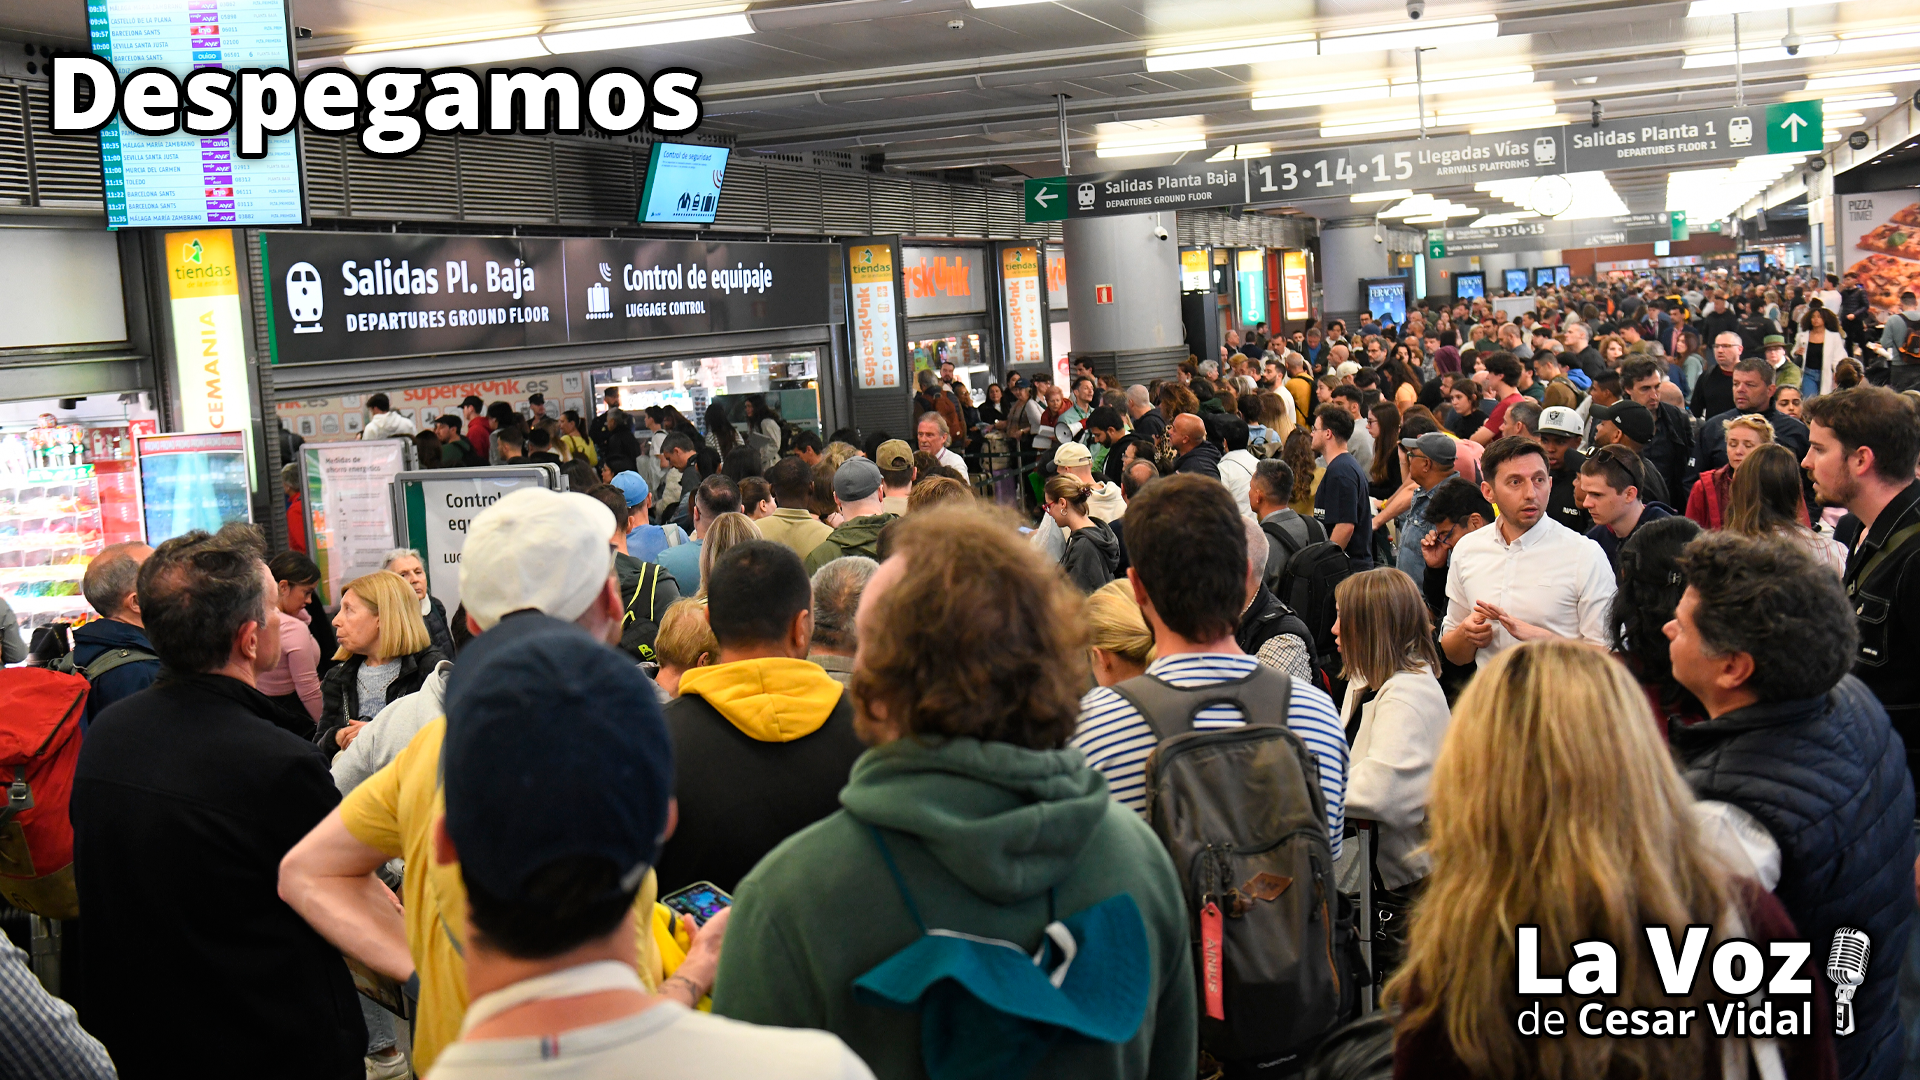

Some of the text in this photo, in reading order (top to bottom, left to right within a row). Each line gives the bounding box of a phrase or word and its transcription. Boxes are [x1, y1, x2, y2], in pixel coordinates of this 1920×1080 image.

[1573, 121, 1717, 149] Salidas Planta 1
[664, 150, 712, 162] Control de seguridad
[1418, 140, 1529, 165] Llegadas Vías
[1617, 140, 1717, 159] DEPARTURES FLOOR 1
[1436, 159, 1530, 176] ARRIVALS PLATFORMS
[1106, 171, 1237, 194] Salidas Planta Baja
[1106, 191, 1213, 209] DEPARTURES GROUND FLOOR
[1849, 200, 1873, 211] PIZZA
[1849, 211, 1872, 222] TIME!
[176, 264, 231, 280] tiendas
[853, 262, 891, 274] tiendas
[1006, 262, 1037, 271] tiendas
[342, 258, 535, 300] Salidas Pl. Baja
[624, 262, 773, 295] Control de equipaje
[626, 300, 706, 318] LUGGAGE CONTROL
[346, 306, 550, 332] DEPARTURES GROUND FLOOR
[1008, 280, 1026, 361] superskunk
[857, 286, 878, 387] superskunk
[1206, 938, 1218, 993] AIRBUS
